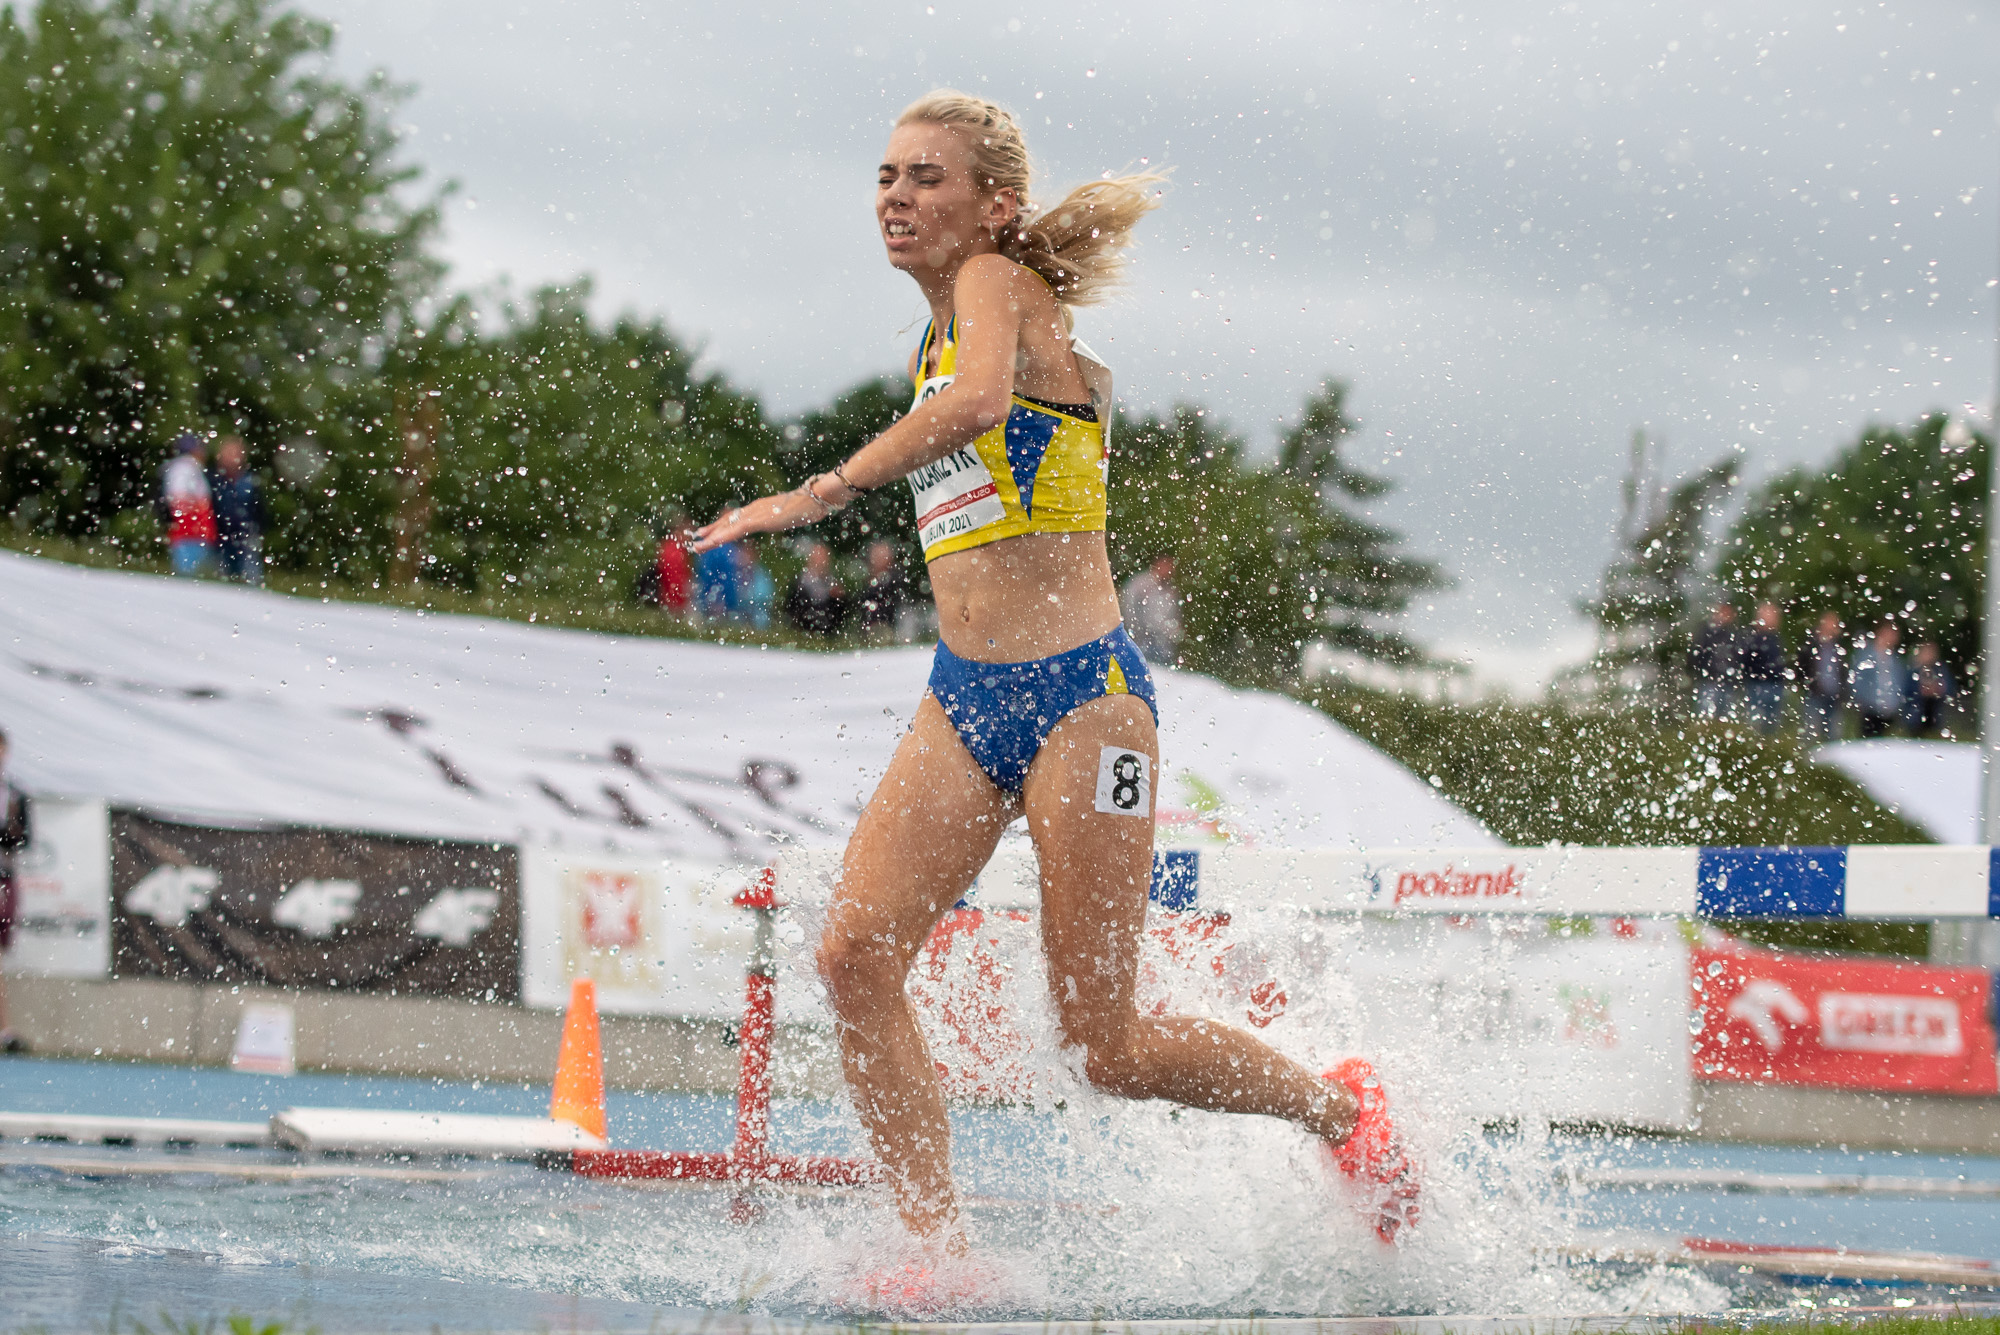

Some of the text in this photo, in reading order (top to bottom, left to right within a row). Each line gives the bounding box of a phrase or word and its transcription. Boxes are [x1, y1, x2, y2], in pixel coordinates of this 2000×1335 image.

[973, 486, 991, 499] U20
[949, 513, 972, 533] 2021
[1112, 754, 1142, 809] 8
[126, 864, 219, 927] 4F
[272, 876, 363, 939] 4F
[413, 886, 500, 947] 4F
